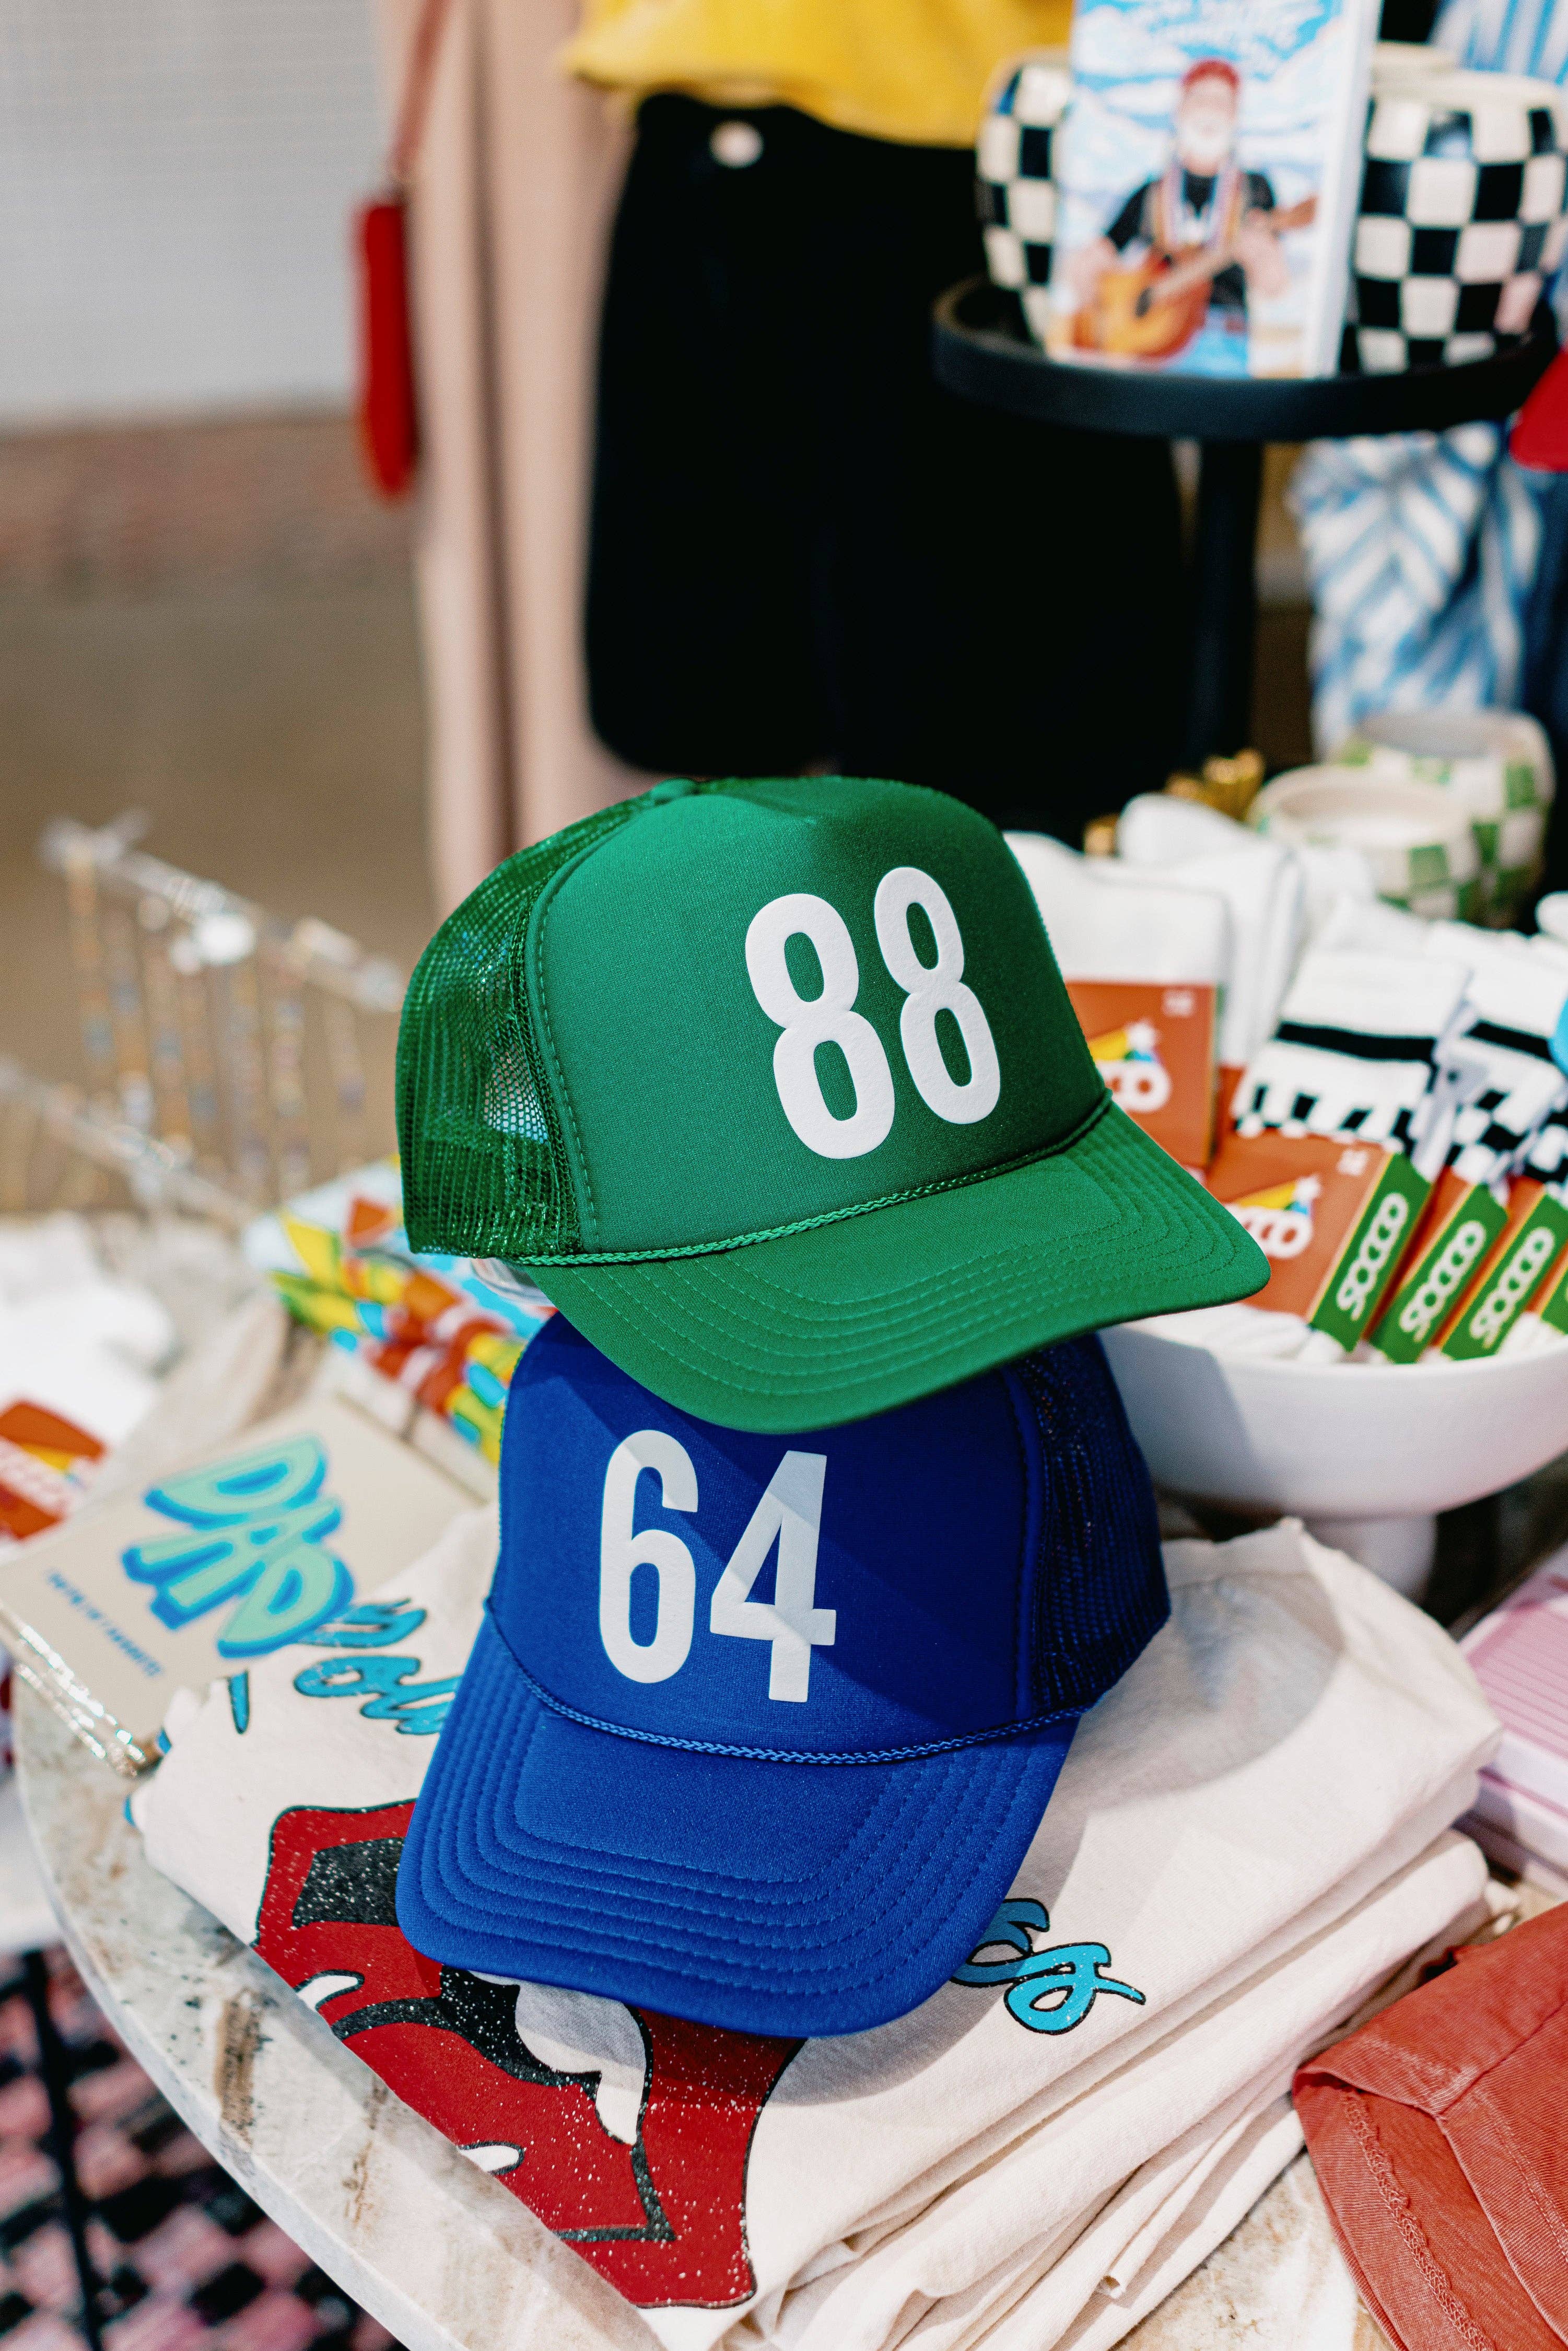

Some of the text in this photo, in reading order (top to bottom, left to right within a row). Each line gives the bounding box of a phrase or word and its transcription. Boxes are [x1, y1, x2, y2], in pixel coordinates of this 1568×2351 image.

[745, 866, 1001, 1159] 88
[121, 1431, 355, 1659] DAD
[599, 1429, 837, 1703] 64
